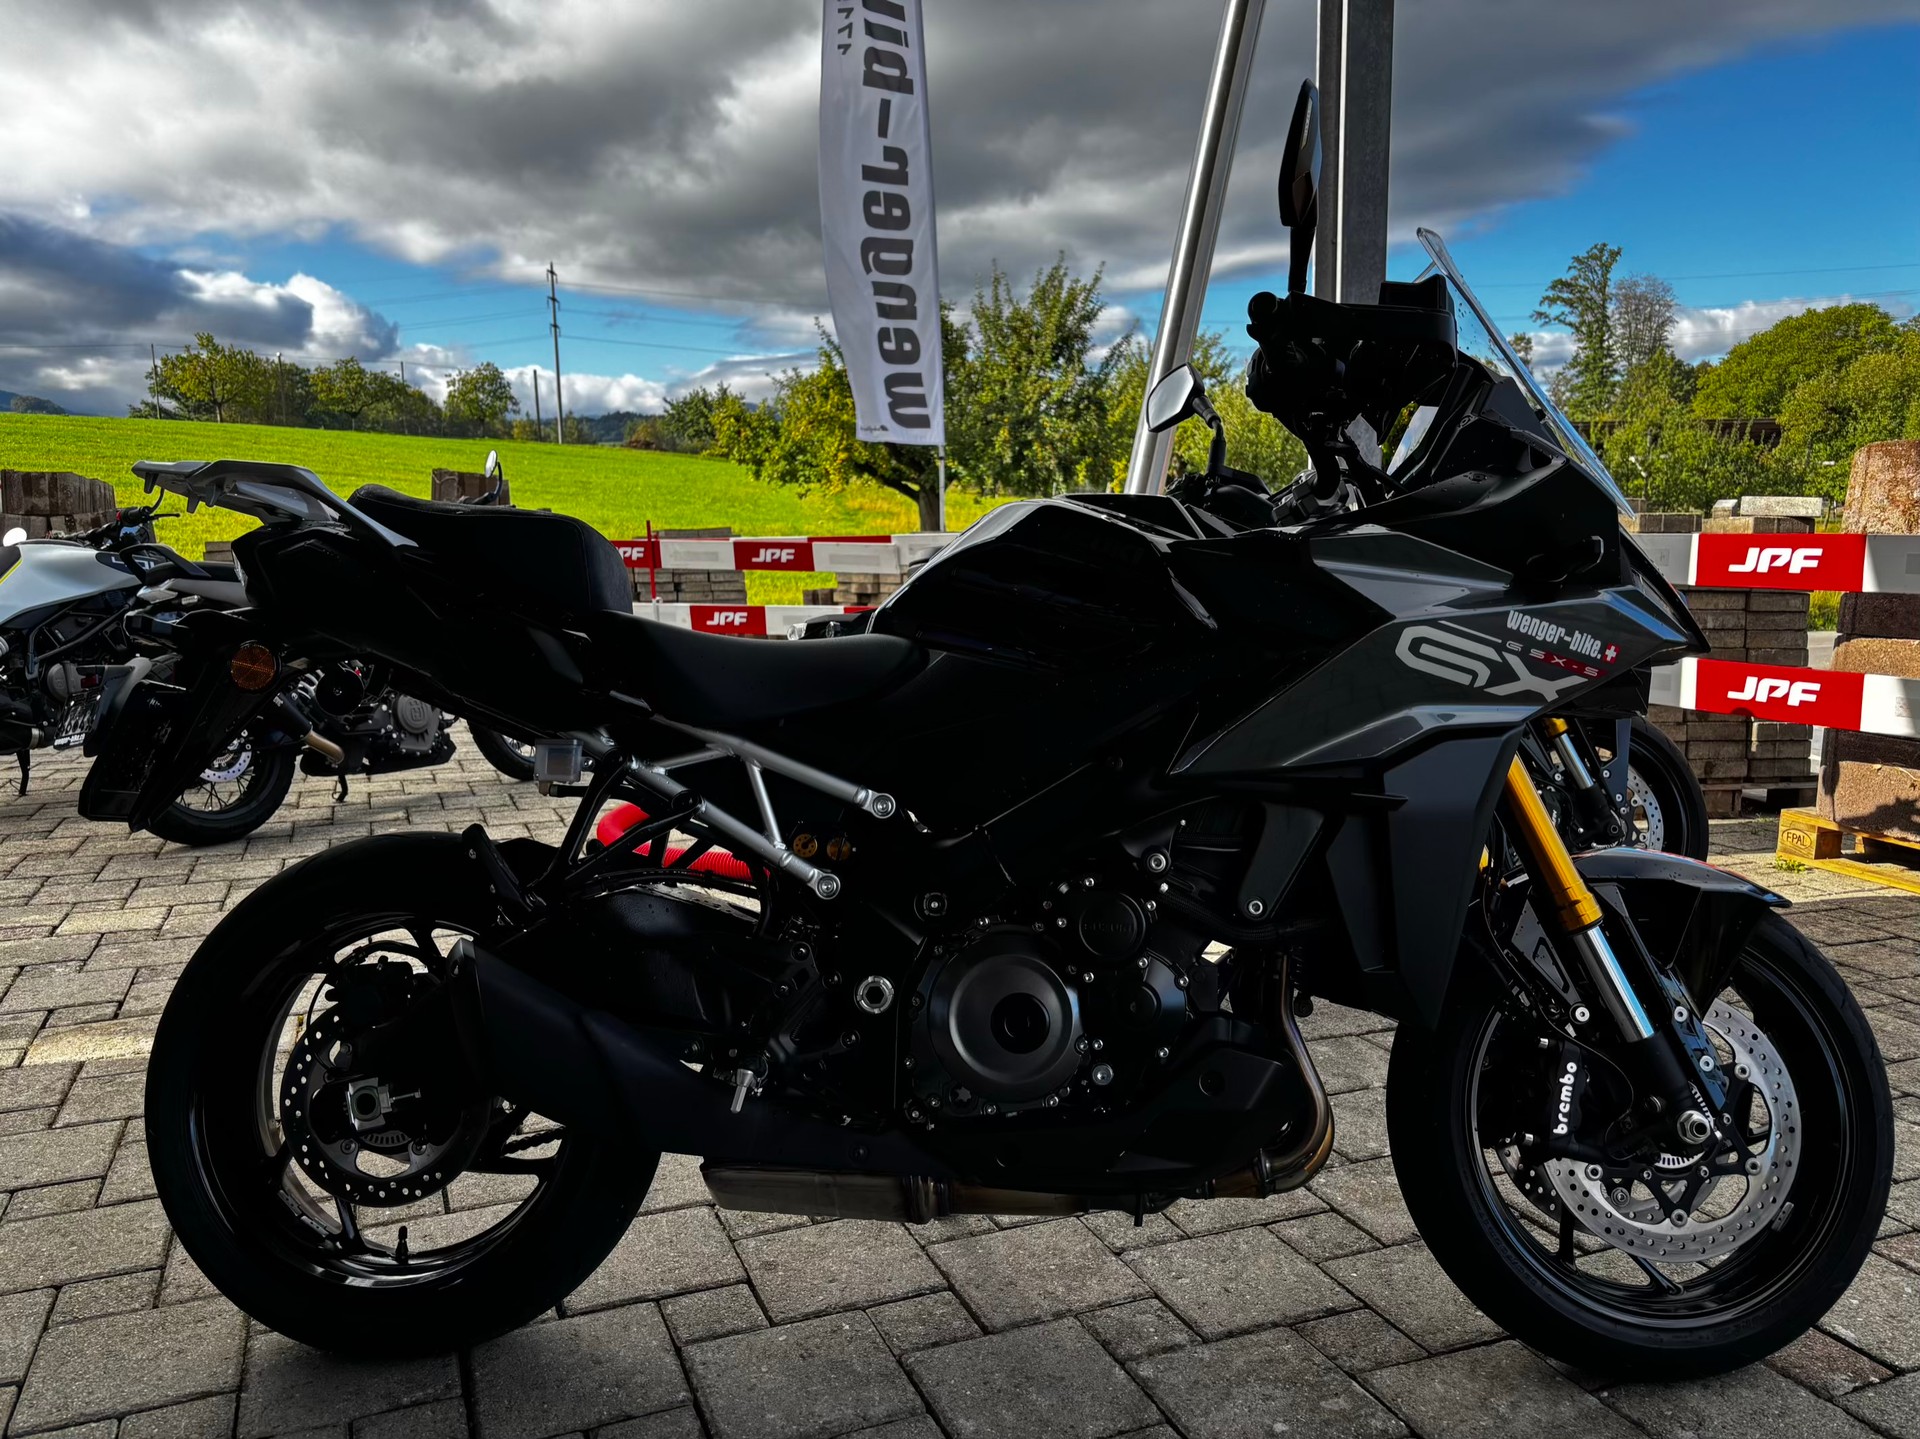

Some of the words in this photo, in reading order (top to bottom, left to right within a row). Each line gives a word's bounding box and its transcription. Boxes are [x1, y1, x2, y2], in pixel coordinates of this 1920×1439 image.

[615, 546, 645, 561] PF
[751, 548, 795, 563] JPF
[1727, 547, 1823, 574] JPF
[706, 611, 748, 626] JPF
[1727, 676, 1821, 707] JPF
[1552, 1061, 1577, 1135] brembo
